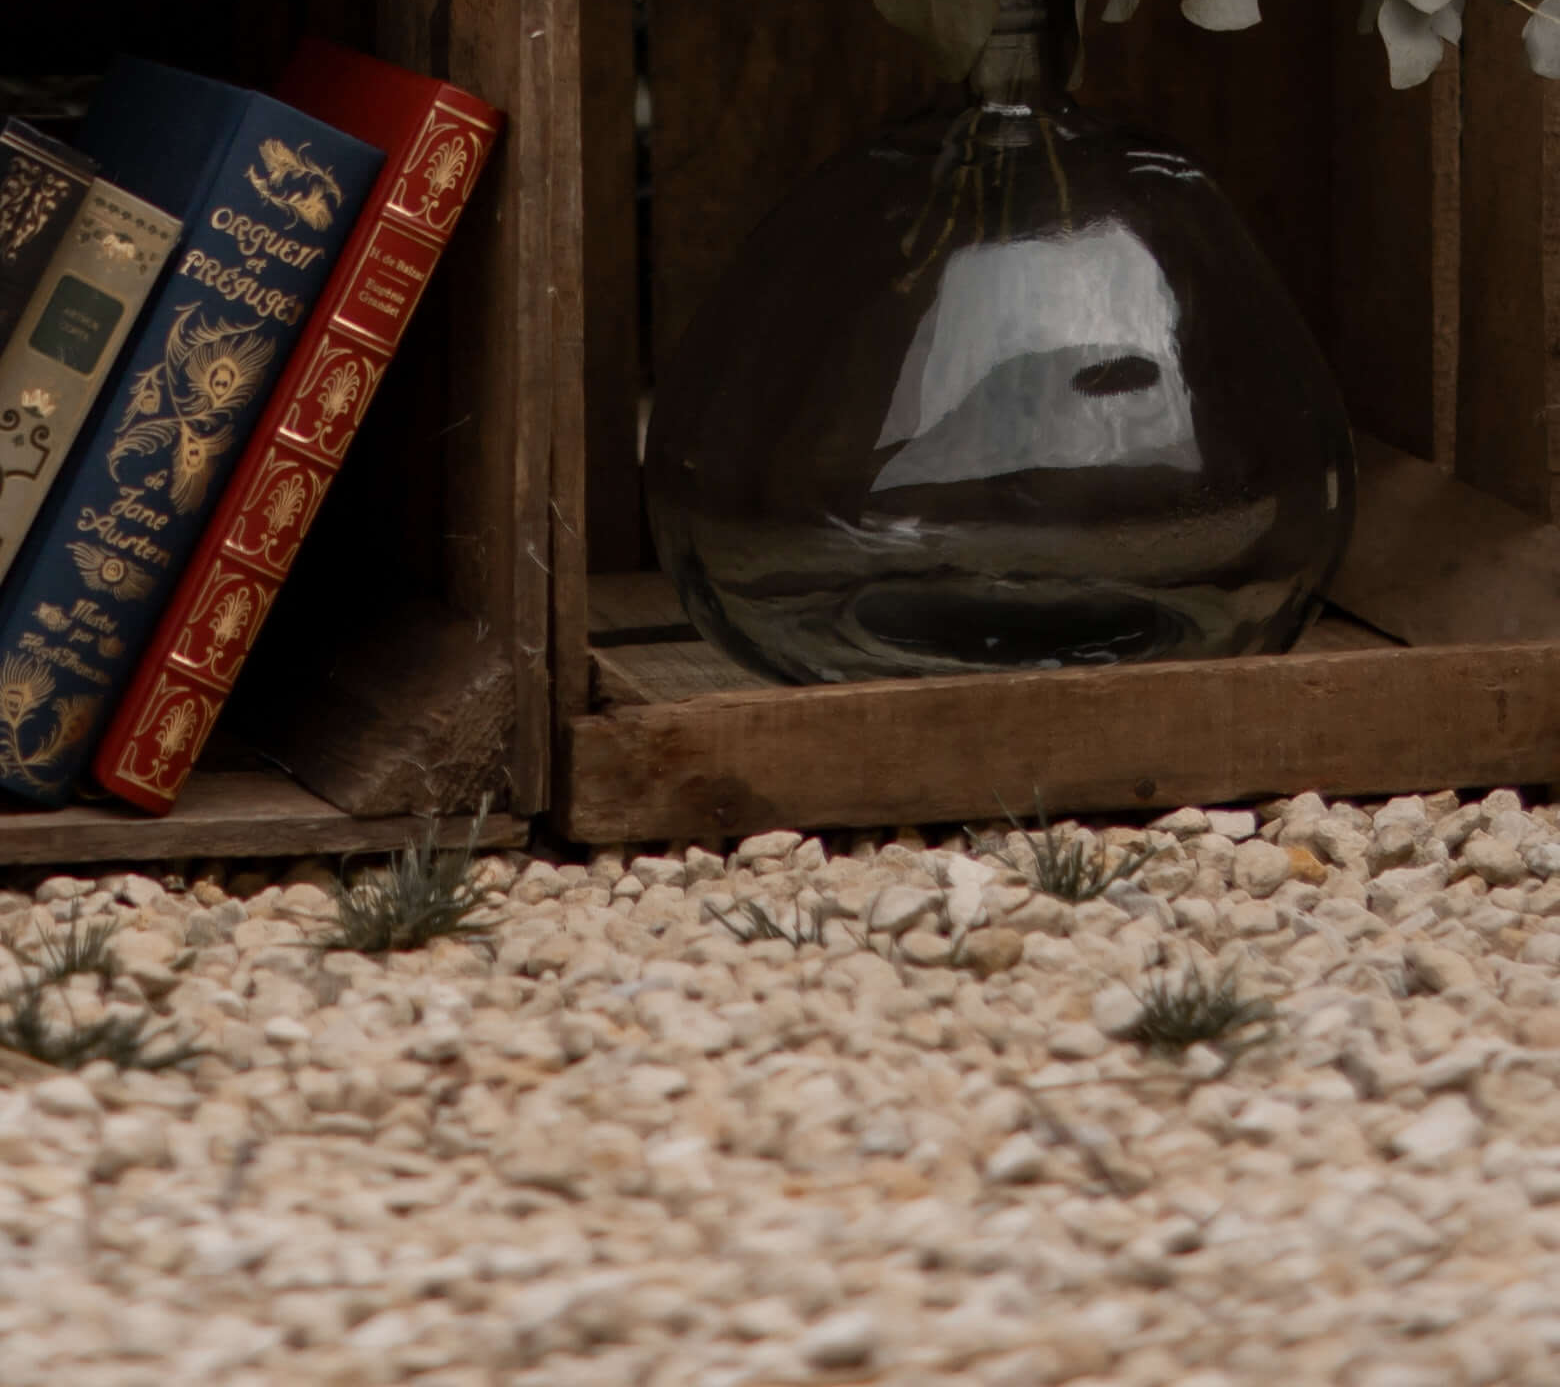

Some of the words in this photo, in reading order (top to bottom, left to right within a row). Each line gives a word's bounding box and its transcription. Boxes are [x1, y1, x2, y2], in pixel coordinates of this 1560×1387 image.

[245, 258, 268, 275] et
[110, 486, 168, 531] Jane
[77, 506, 171, 569] Austen
